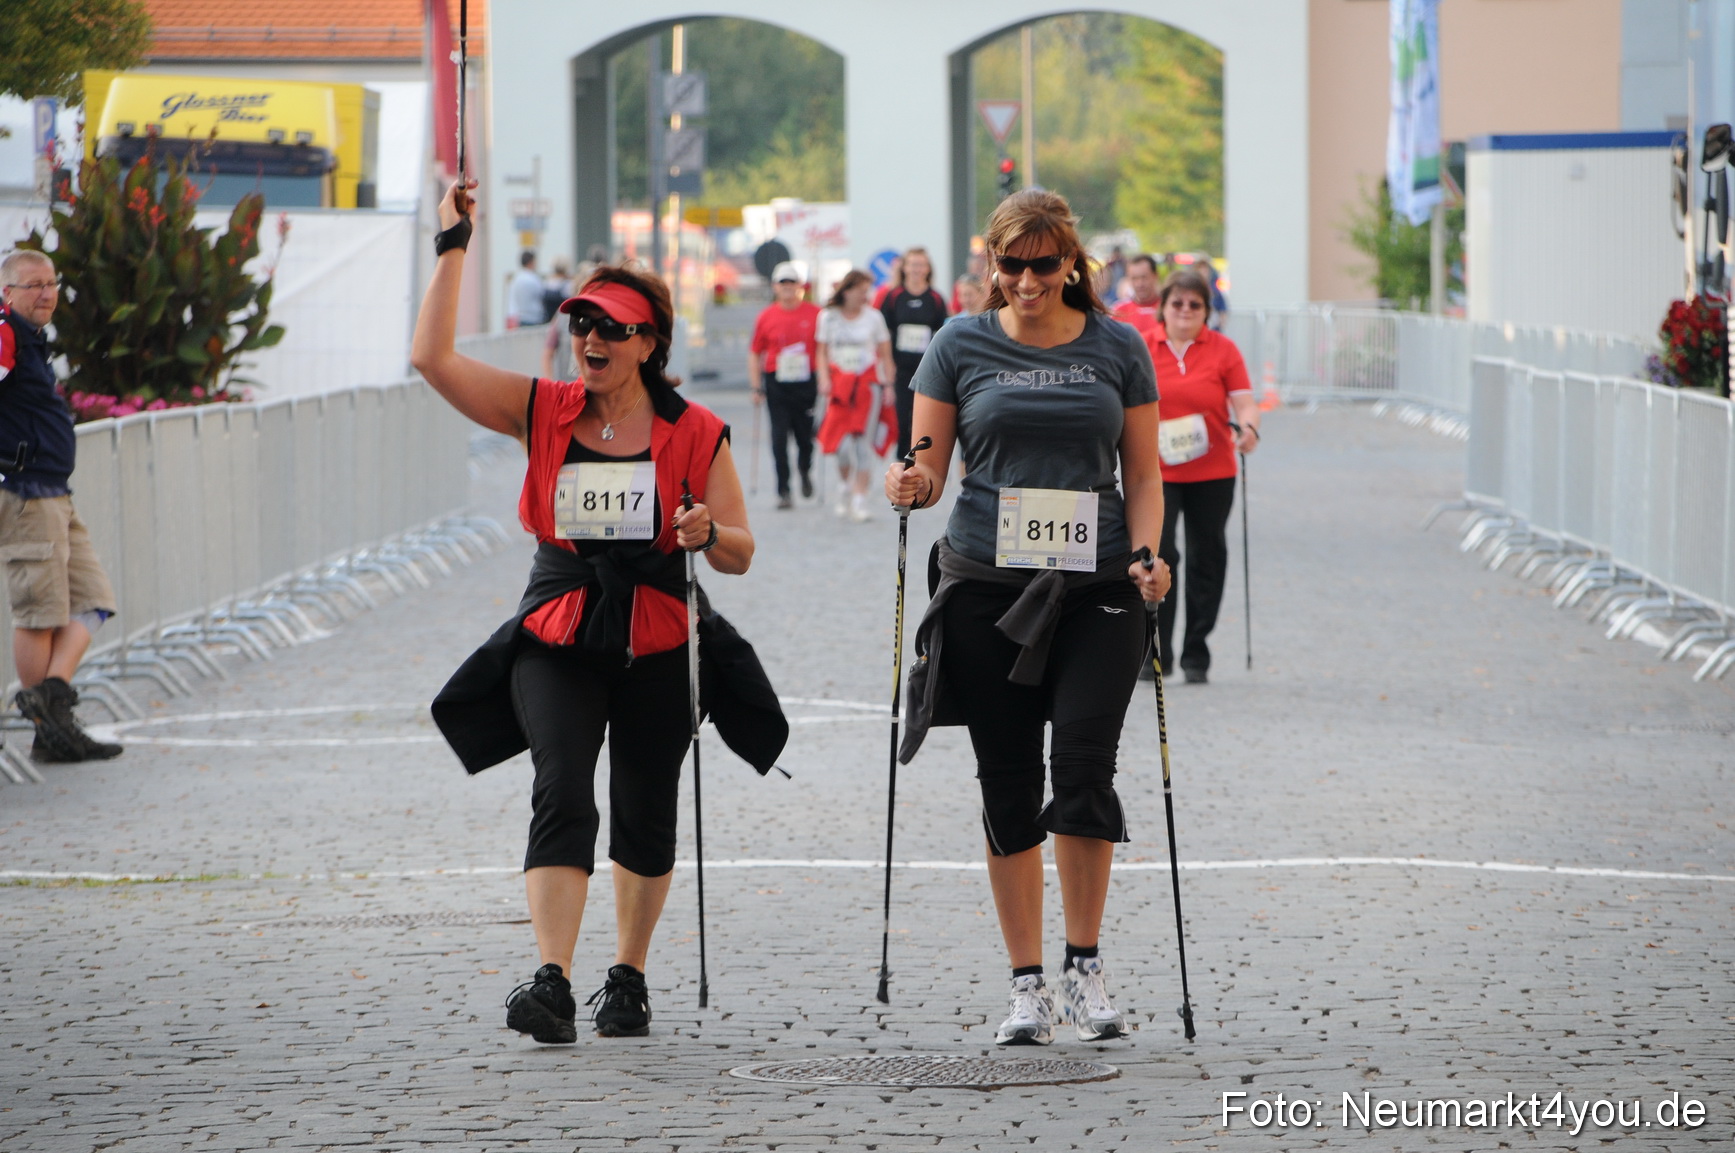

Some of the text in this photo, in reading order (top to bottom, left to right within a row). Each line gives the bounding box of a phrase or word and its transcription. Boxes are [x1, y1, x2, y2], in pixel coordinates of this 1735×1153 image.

[160, 93, 274, 118] Glossner
[219, 109, 270, 123] Bier
[996, 364, 1096, 390] esprit
[583, 490, 645, 511] 8117
[1003, 517, 1010, 529] N
[1027, 519, 1088, 544] 8118
[1058, 557, 1095, 567] PFLEIDERER
